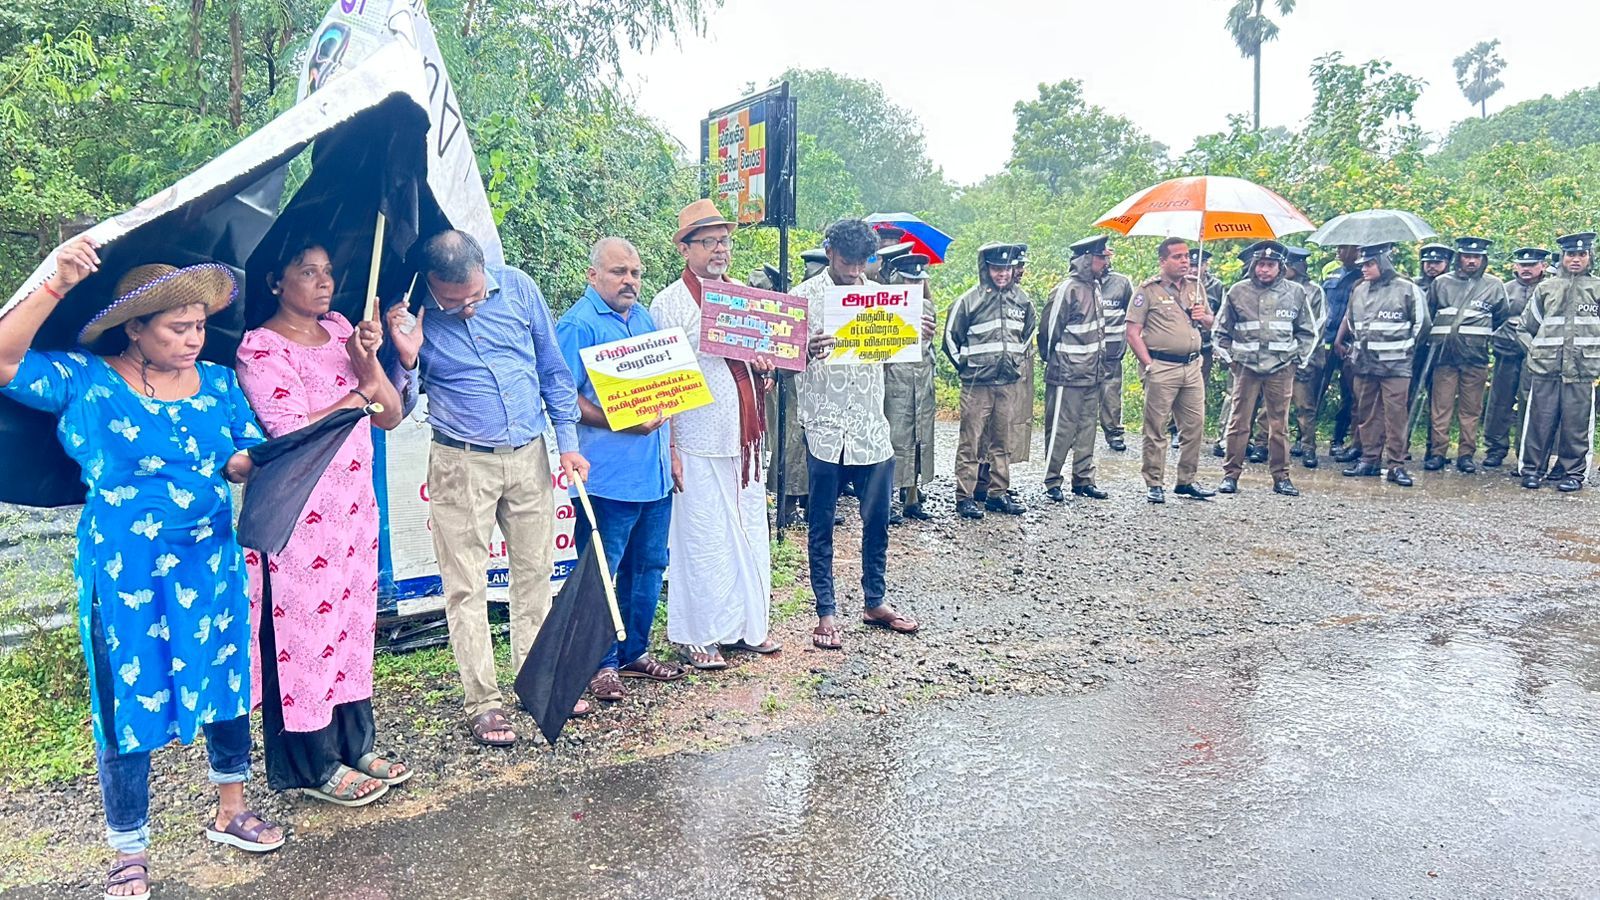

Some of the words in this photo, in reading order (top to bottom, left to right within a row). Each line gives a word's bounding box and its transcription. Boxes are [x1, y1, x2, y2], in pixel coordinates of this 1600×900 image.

[842, 291, 908, 308] அரசே!
[856, 311, 894, 323] தையிட்டி
[1007, 308, 1026, 319] POLIC
[1377, 310, 1404, 319] POLICE
[850, 324, 900, 337] சட்டவிரோத
[595, 334, 680, 362] சிறிலங்கா
[616, 350, 672, 372] அரசே!
